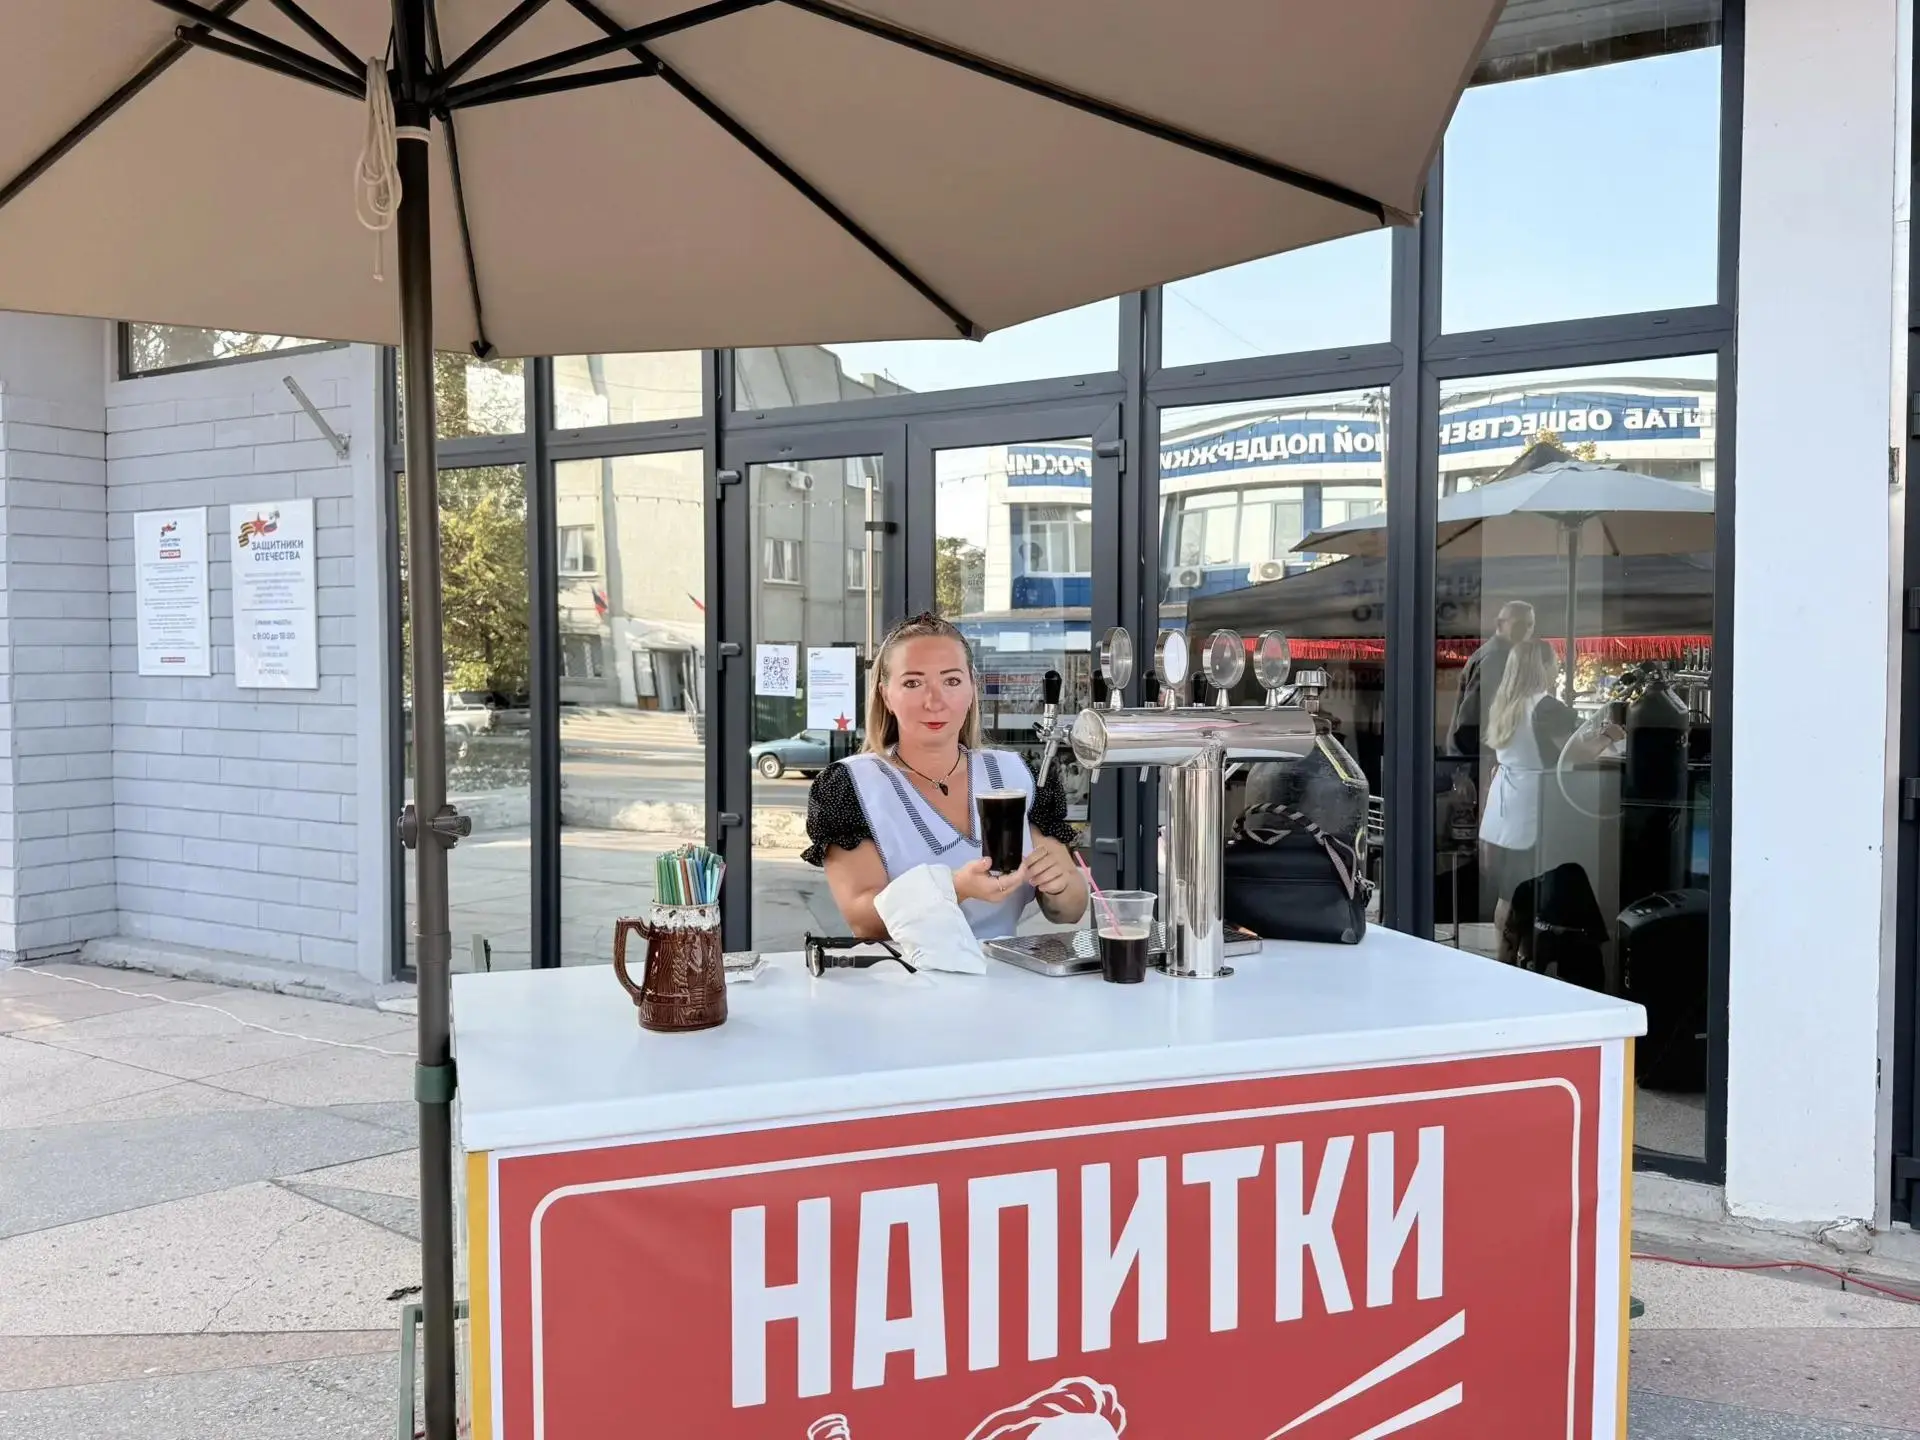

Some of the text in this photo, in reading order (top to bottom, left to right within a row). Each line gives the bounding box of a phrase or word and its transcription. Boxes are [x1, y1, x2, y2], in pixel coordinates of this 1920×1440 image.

[251, 539, 304, 551] ЗАЩИТНИКИ
[254, 550, 301, 562] ОТЕЧЕСТВА
[731, 1124, 1446, 1409] НАПИТКИ
